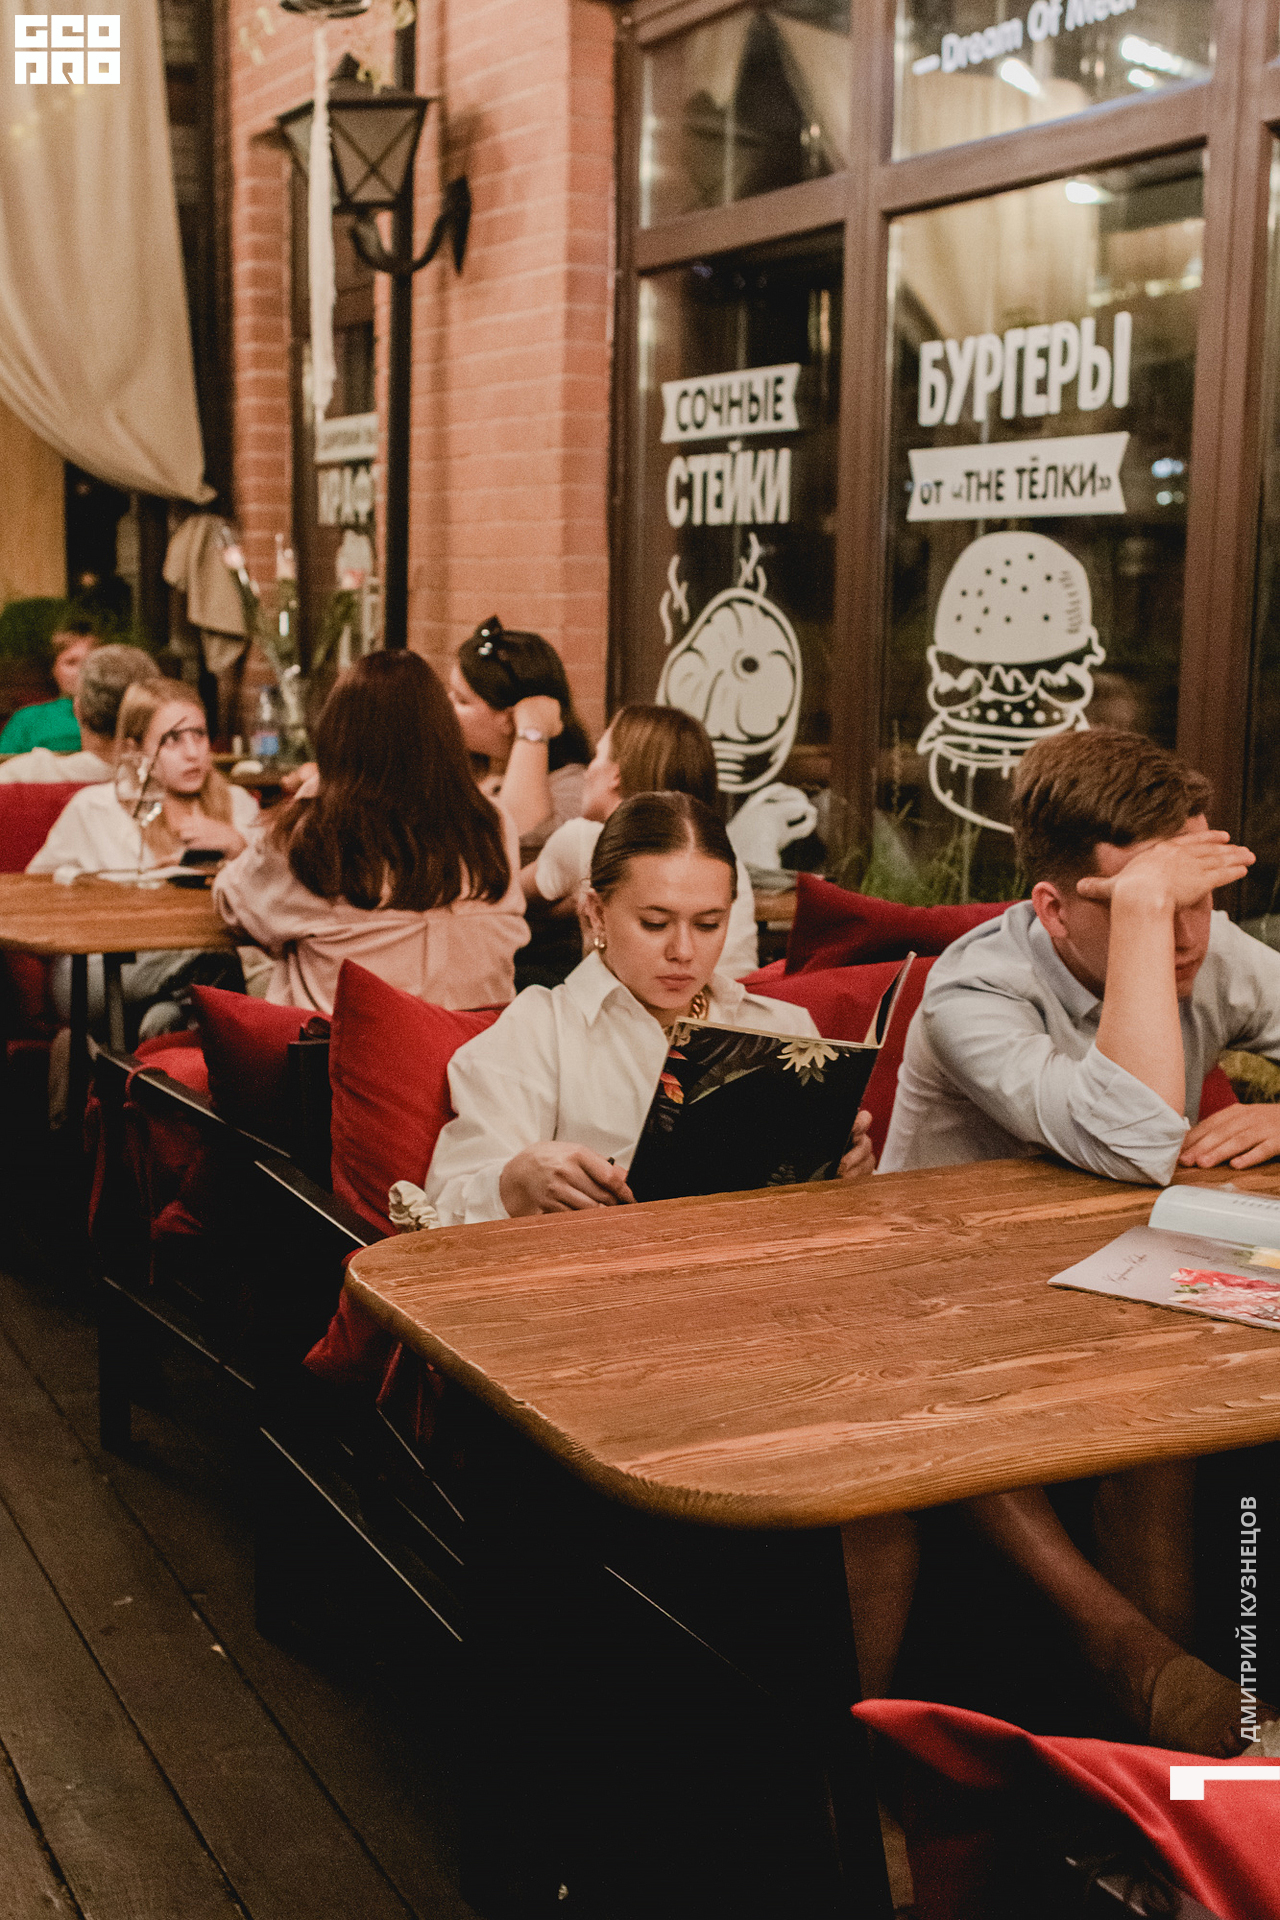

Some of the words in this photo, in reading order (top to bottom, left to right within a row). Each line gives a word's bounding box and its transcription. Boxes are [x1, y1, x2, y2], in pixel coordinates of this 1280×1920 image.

[941, 17, 1024, 74] Dream
[1027, 0, 1063, 43] Of
[676, 376, 784, 432] СОЧНЫЕ
[918, 311, 1132, 427] БУРГЕРЫ
[666, 440, 792, 528] СТЕЙКИ
